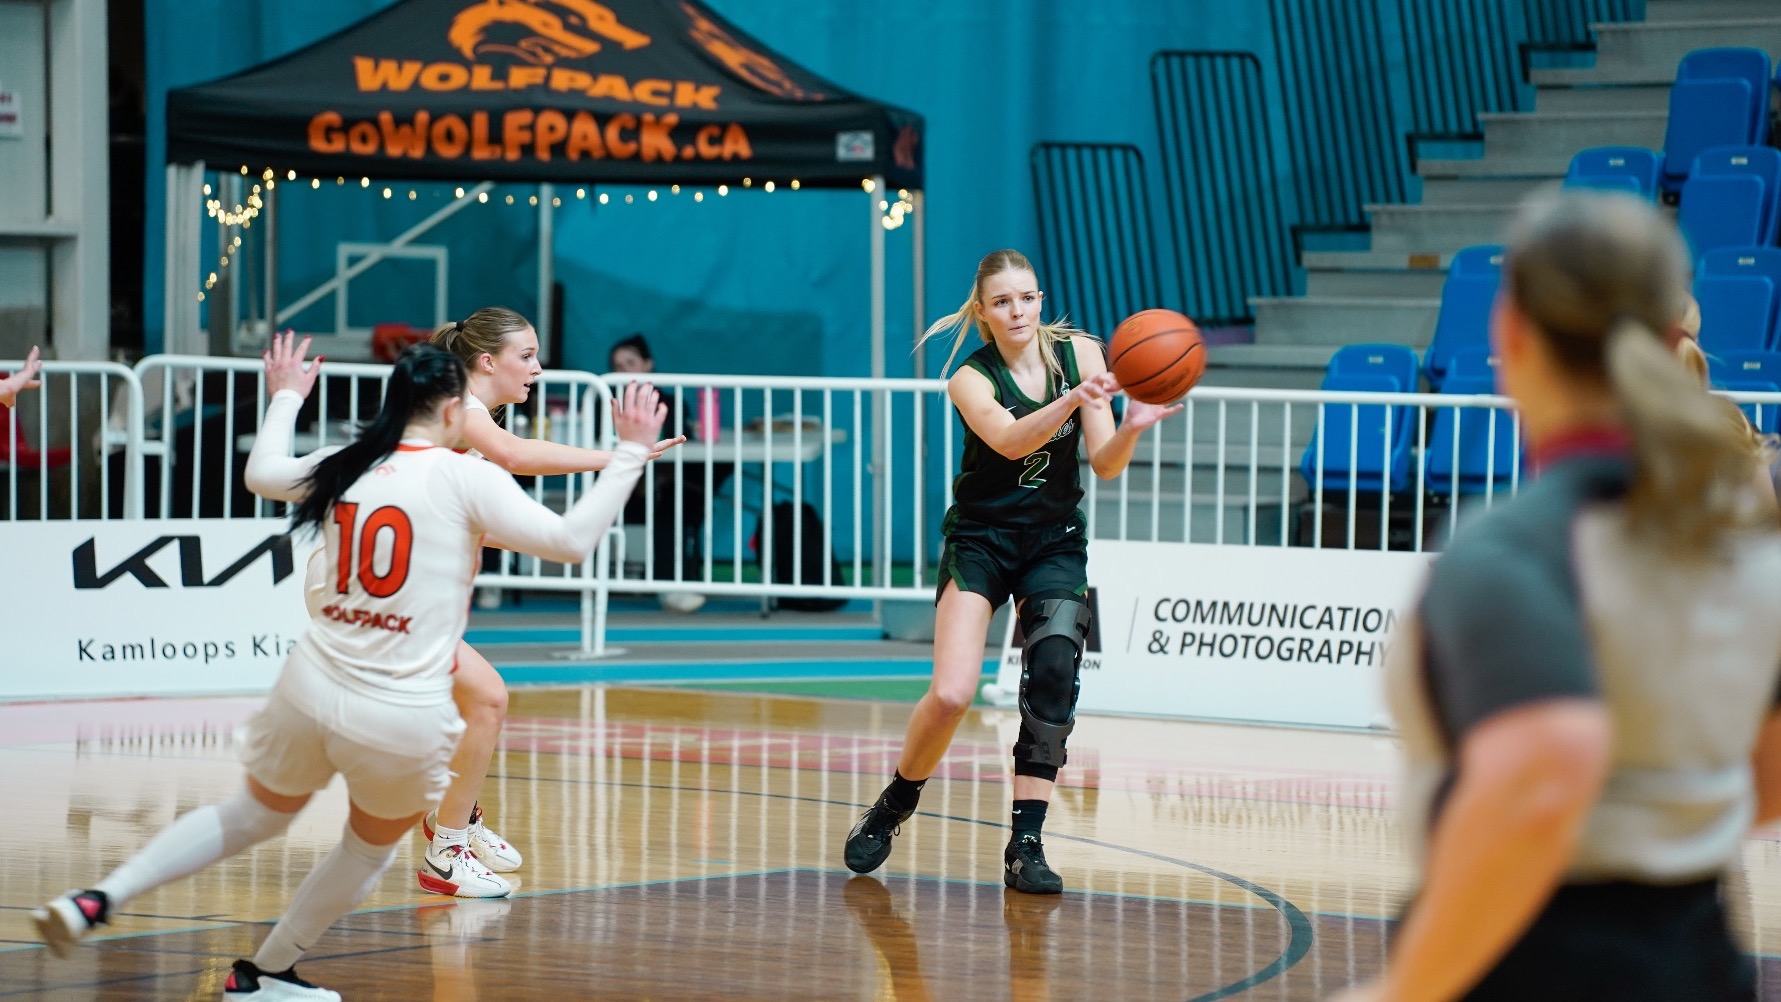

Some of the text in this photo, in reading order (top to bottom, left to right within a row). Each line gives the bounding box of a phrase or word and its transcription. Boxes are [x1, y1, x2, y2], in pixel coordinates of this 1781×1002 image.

[352, 55, 721, 110] WOLFPACK
[1018, 451, 1051, 489] 2
[333, 502, 414, 598] 10
[78, 636, 236, 665] Kamloops
[1147, 629, 1170, 655] &
